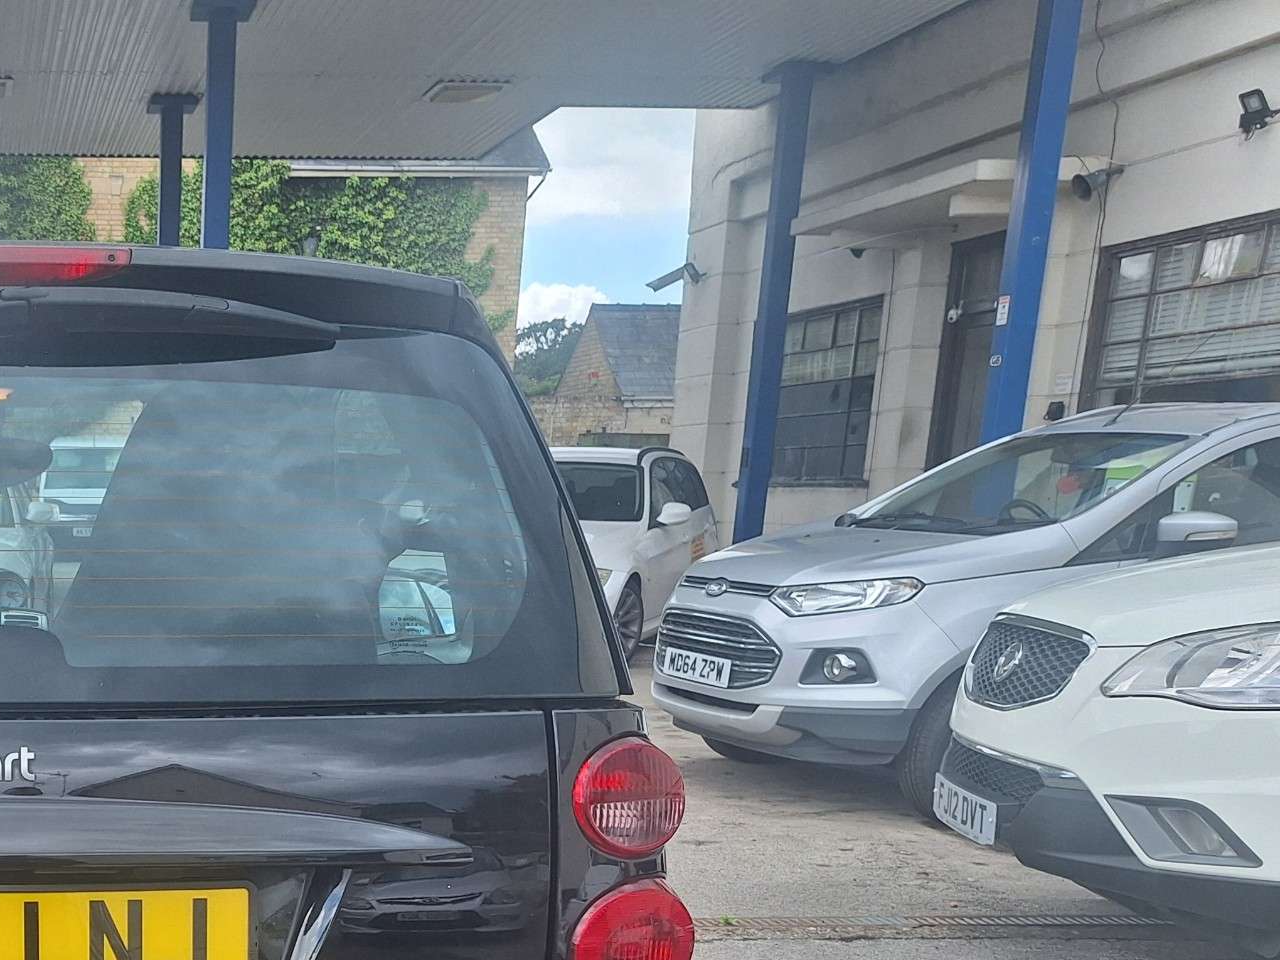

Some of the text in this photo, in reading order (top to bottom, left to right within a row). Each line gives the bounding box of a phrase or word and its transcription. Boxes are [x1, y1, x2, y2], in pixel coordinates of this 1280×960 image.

[668, 651, 725, 682] MD64 ZPW
[938, 782, 987, 834] FJ12 DVT
